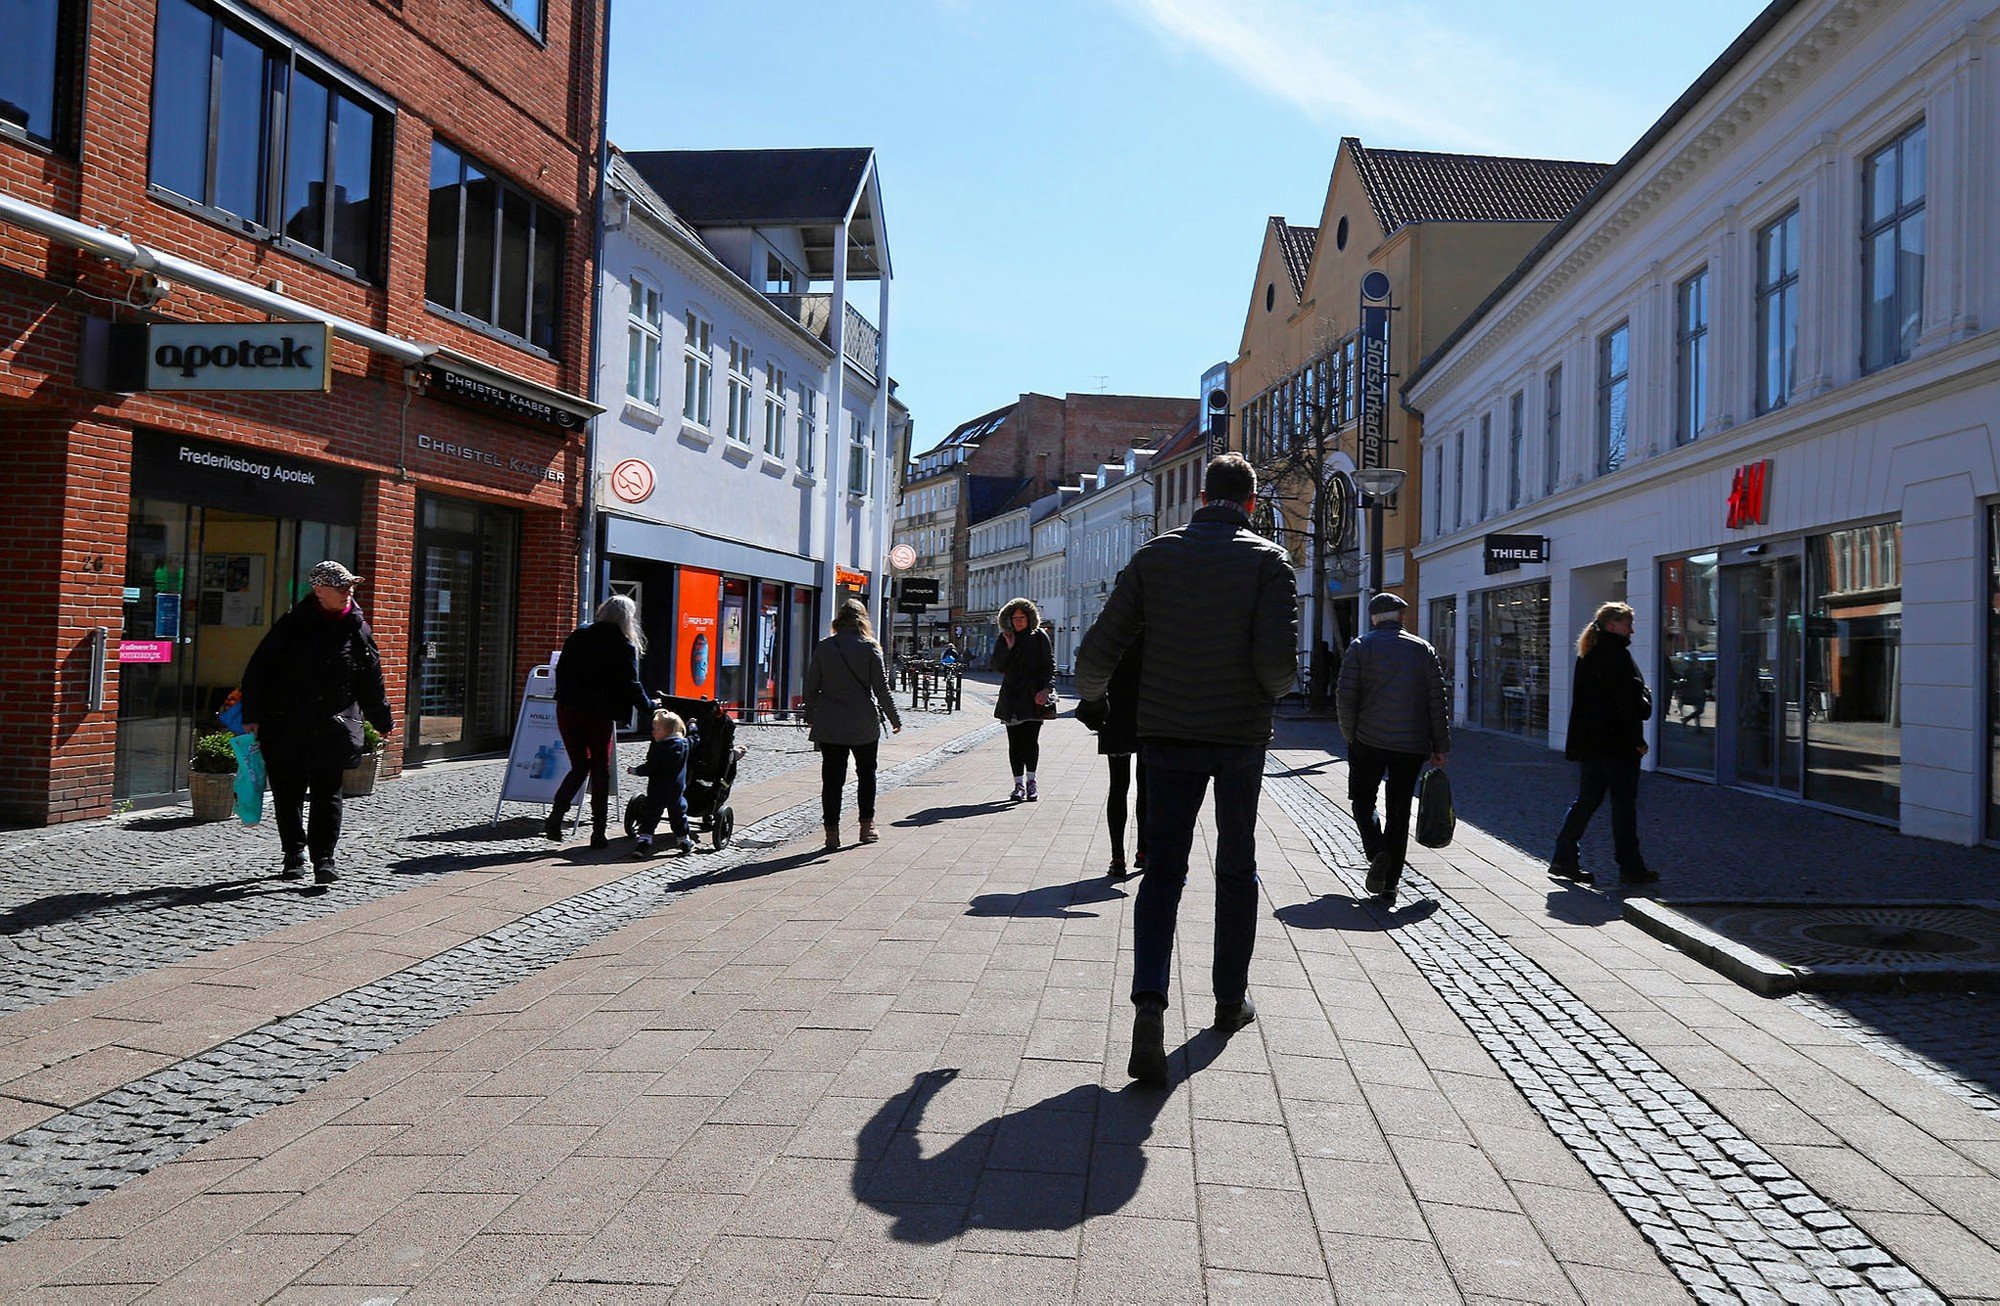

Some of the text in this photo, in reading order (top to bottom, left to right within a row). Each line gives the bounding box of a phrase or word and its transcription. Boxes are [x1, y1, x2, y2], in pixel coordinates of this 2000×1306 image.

[155, 337, 313, 377] apotek
[1366, 337, 1383, 468] SlotsArkadern
[180, 446, 315, 485] Frederiksborg Apotek
[1491, 549, 1538, 559] THIELE
